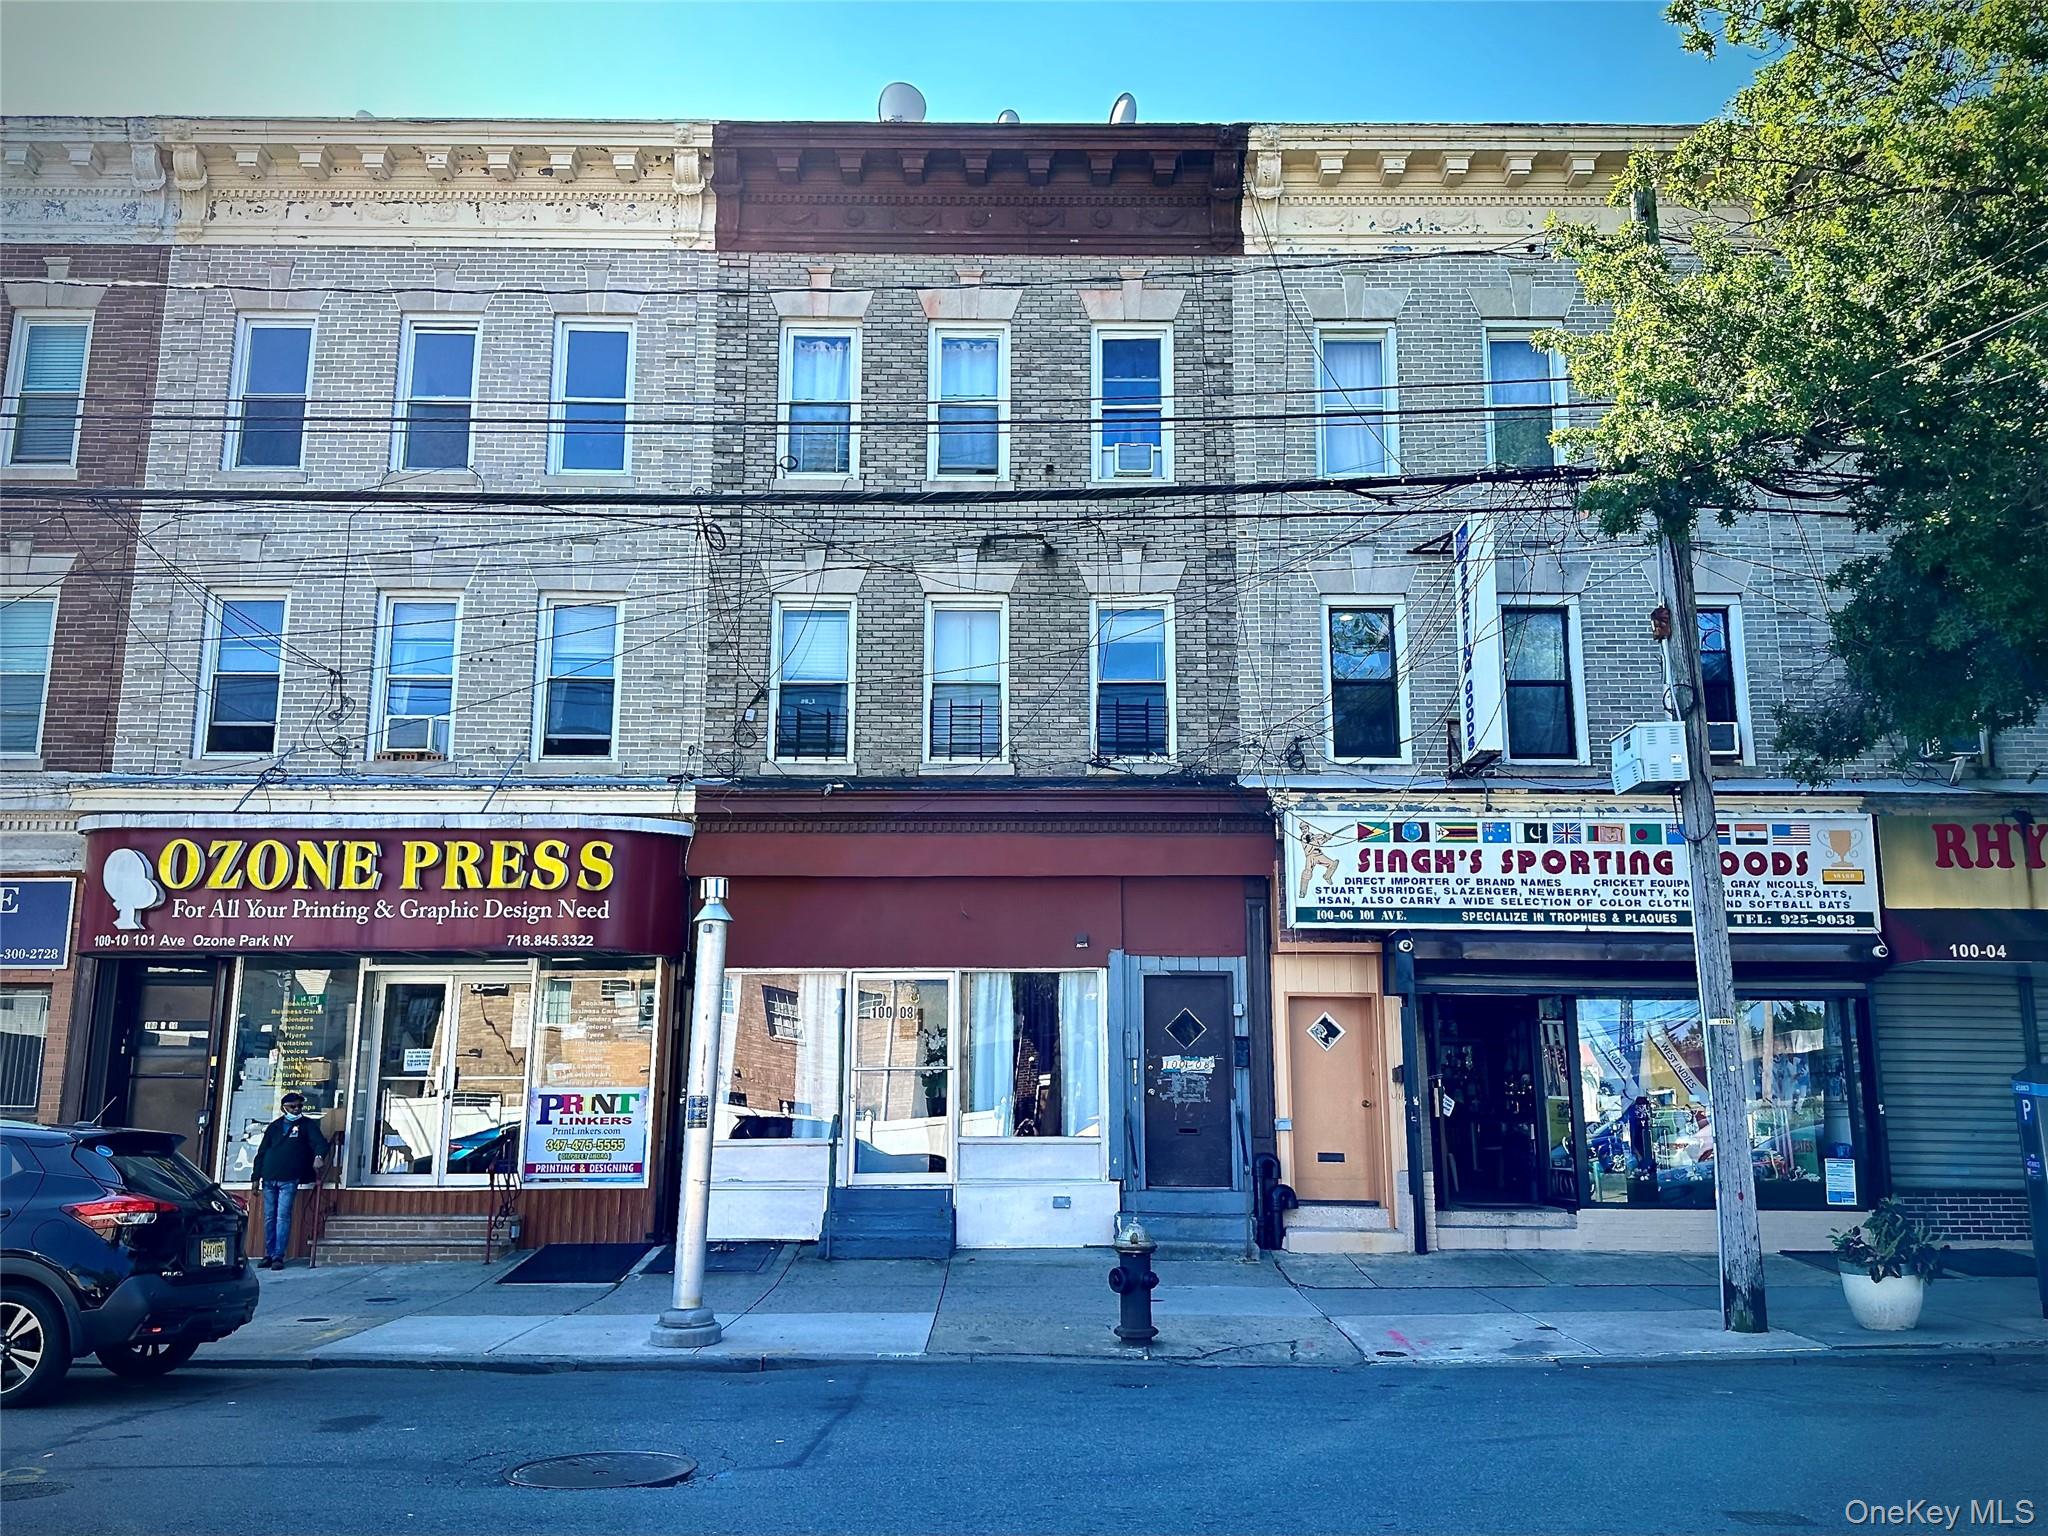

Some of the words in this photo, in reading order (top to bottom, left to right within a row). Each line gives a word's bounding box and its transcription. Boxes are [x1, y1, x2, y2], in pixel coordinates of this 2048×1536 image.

[1464, 679, 1476, 752] GOODS
[157, 838, 382, 891] OZONE
[399, 839, 615, 891] PRESS
[1357, 848, 1483, 874] SINGH'S
[1501, 849, 1674, 876] SPORTING
[1719, 850, 1809, 876] OODS
[1344, 877, 1386, 885] DIRECT
[1390, 877, 1450, 885] IMPORTER
[1455, 877, 1471, 886] OF
[1476, 878, 1515, 886] BRAND
[1520, 878, 1562, 887] NAMES
[1593, 878, 1645, 887] CRICKET
[1731, 880, 1761, 889] GRAY
[1766, 880, 1818, 890] NICOLLS,
[1315, 886, 1363, 895] STUART
[1370, 886, 1438, 896] SURRIDGE,
[1443, 887, 1523, 897] SLAZENGER,
[1528, 888, 1602, 898] NEWBERRY,
[1612, 888, 1667, 898] COUNTY,
[1318, 896, 1355, 906] HSAN,
[1361, 896, 1394, 905] ALSO
[1400, 896, 1442, 905] CARRY
[1449, 897, 1456, 905] A
[1463, 897, 1494, 906] WIDE
[1500, 897, 1571, 907] SELECTION
[1577, 899, 1593, 907] OF
[1600, 899, 1642, 908] COLOR
[1726, 900, 1743, 908] ND
[1749, 900, 1813, 909] SOFTBALL
[1819, 901, 1851, 909] BATS
[171, 898, 205, 920] For
[208, 898, 240, 920] All
[246, 898, 286, 920] Your
[291, 898, 370, 925] Printing
[373, 899, 395, 920] &
[399, 898, 479, 925] Graphic
[483, 898, 552, 925] Design
[557, 898, 610, 920] Need
[1316, 910, 1354, 920] 100-06
[1359, 910, 1375, 920] 101
[1381, 911, 1407, 921] AVE.
[1461, 911, 1528, 922] SPECIALIZE
[1533, 912, 1545, 922] IN
[1550, 912, 1607, 922] TROPHIES
[1611, 913, 1620, 923] &
[1625, 913, 1678, 924] PLAQUES
[1733, 913, 1772, 924] TEL:
[1780, 914, 1856, 925] 925-9058
[94, 935, 129, 947] 100-10
[132, 935, 156, 947] 101
[160, 935, 185, 947] Ave
[193, 935, 236, 947] Ozone
[239, 935, 270, 947] Park
[273, 935, 294, 947] NY
[506, 935, 594, 947] 718.845.3322
[1949, 944, 2007, 958] 100-04
[872, 1006, 892, 1018] 100
[900, 1006, 914, 1018] 08
[1661, 1042, 1678, 1065] WEST
[1674, 1063, 1697, 1089] INDIES
[536, 1093, 640, 1125] PRINT
[559, 1117, 632, 1125] LINKERS
[552, 1127, 621, 1135] PrintLinkers.com
[545, 1138, 626, 1151] 347-475-5555
[535, 1163, 576, 1173] PRINTING
[579, 1164, 586, 1173] &
[589, 1163, 635, 1173] DESIGNING
